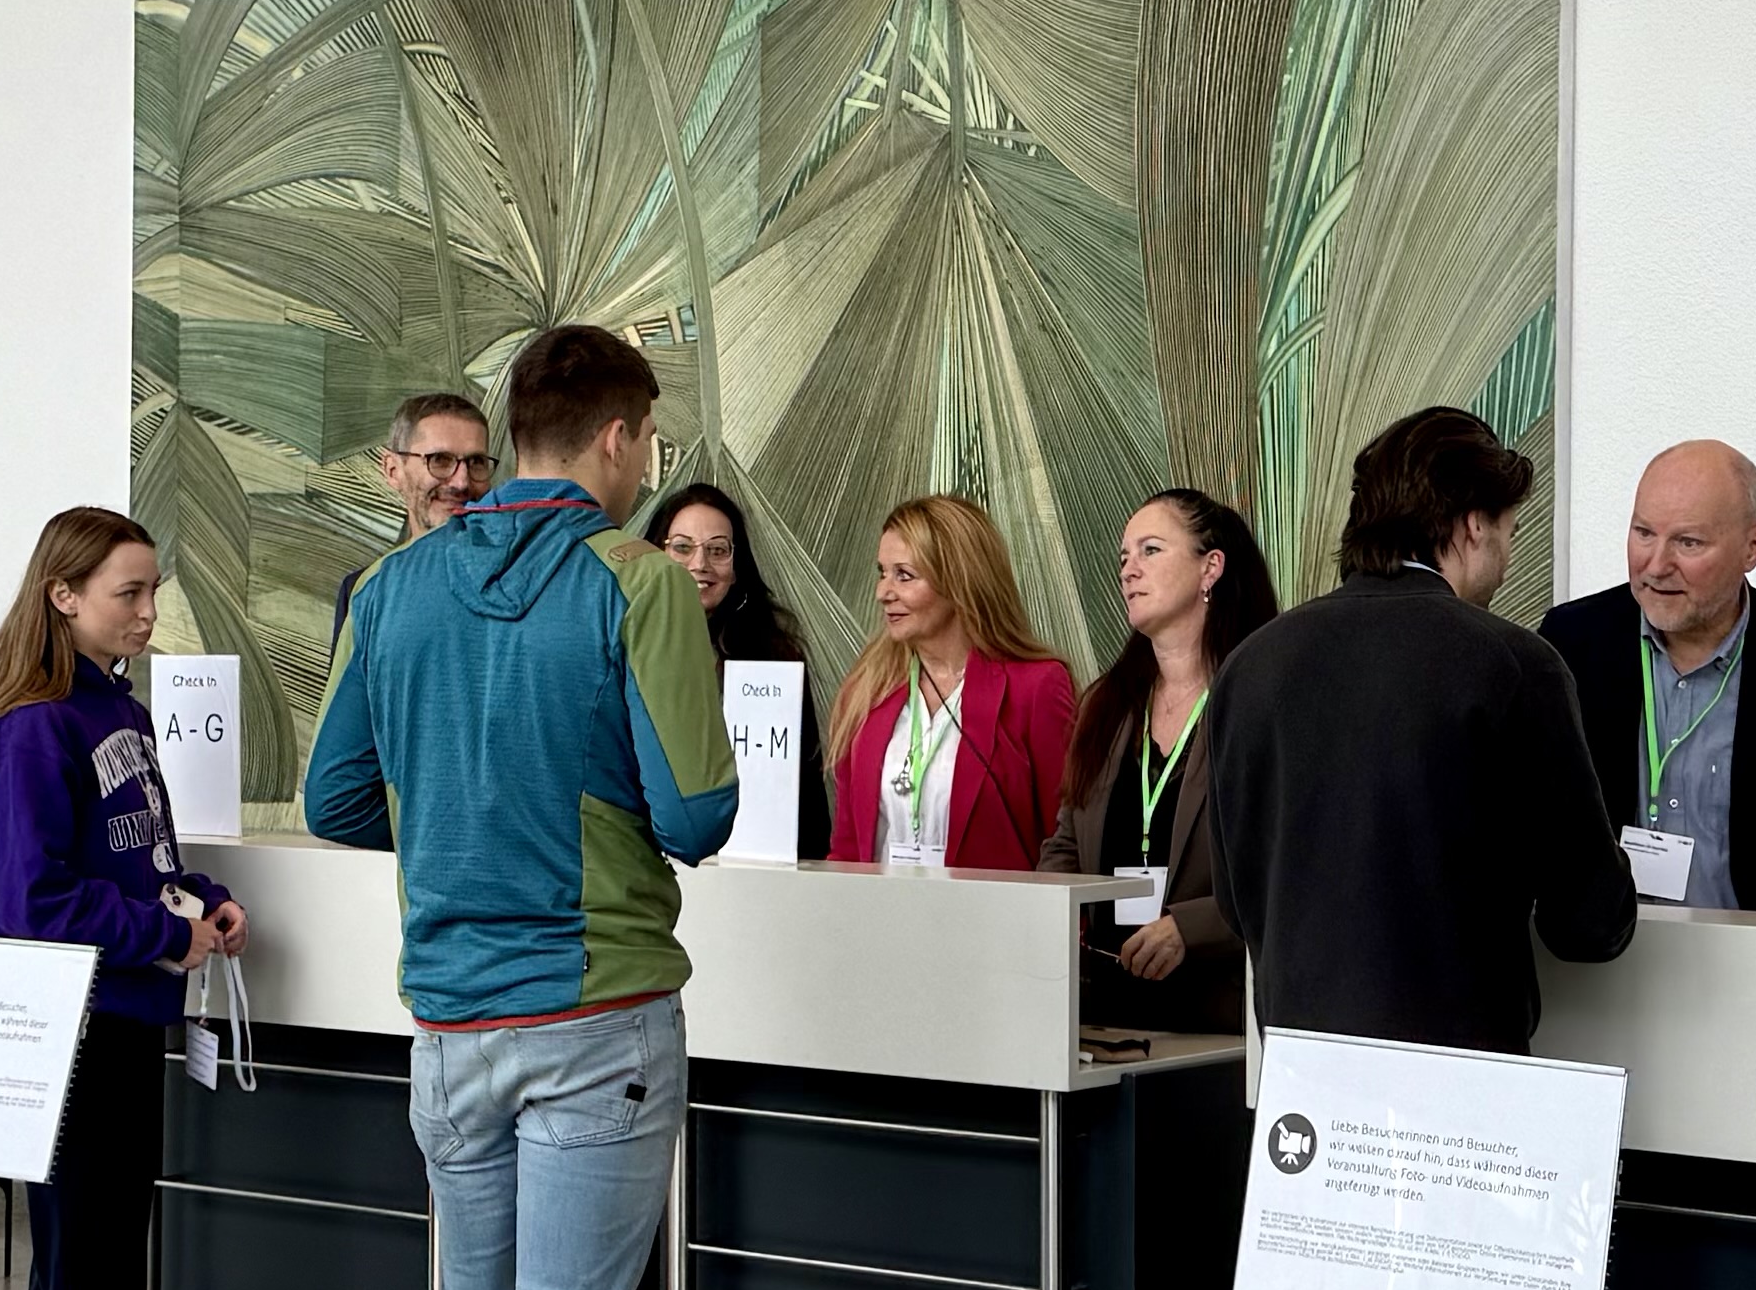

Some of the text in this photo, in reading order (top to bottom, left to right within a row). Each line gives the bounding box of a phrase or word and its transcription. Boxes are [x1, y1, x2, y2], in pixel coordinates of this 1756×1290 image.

[173, 675, 204, 687] Check
[1331, 1119, 1359, 1135] Liebe
[1361, 1123, 1440, 1145] Besucherinnen
[1442, 1136, 1464, 1148] und
[1327, 1157, 1398, 1180] Veranstaltung
[1431, 1174, 1453, 1187] und
[1455, 1175, 1550, 1201] Videoaufnahmen
[1423, 1152, 1444, 1167] hin,
[1446, 1155, 1471, 1170] dass
[1524, 1165, 1560, 1182] dieser
